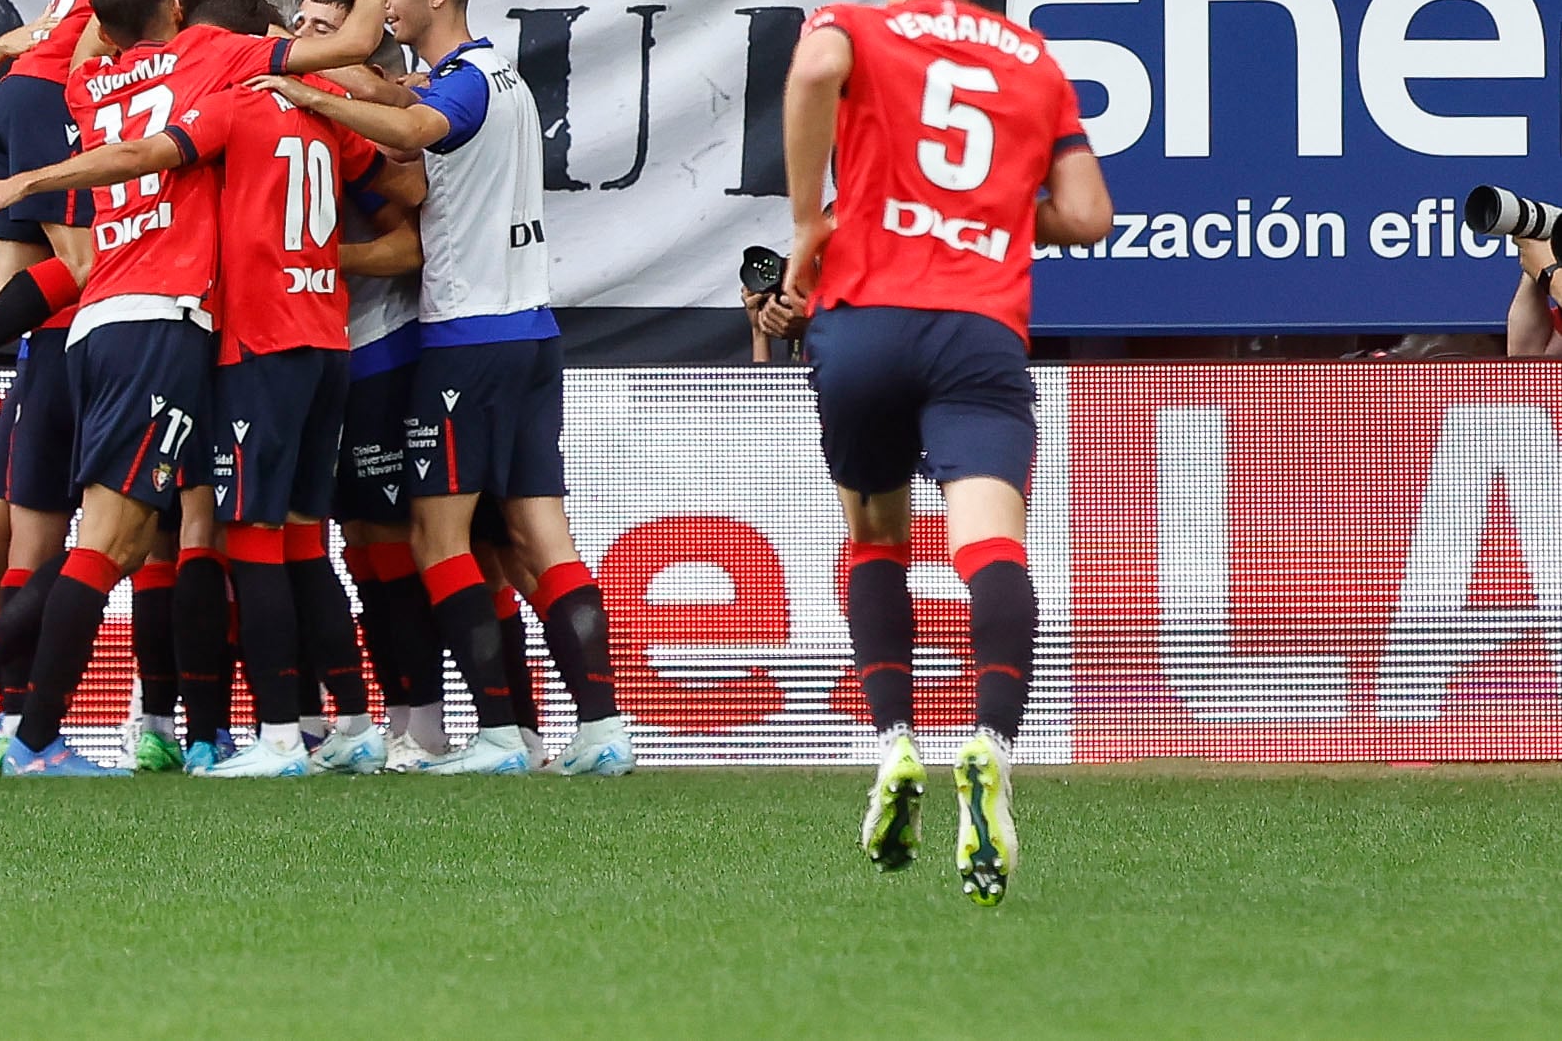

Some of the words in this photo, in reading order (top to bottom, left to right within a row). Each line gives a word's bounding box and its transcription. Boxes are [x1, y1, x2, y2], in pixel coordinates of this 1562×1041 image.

[916, 57, 1000, 193] 5
[273, 136, 338, 251] 10
[510, 219, 545, 249] DI
[882, 198, 1011, 263] DIGI
[1030, 197, 1345, 261] zación
[158, 407, 194, 460] 17
